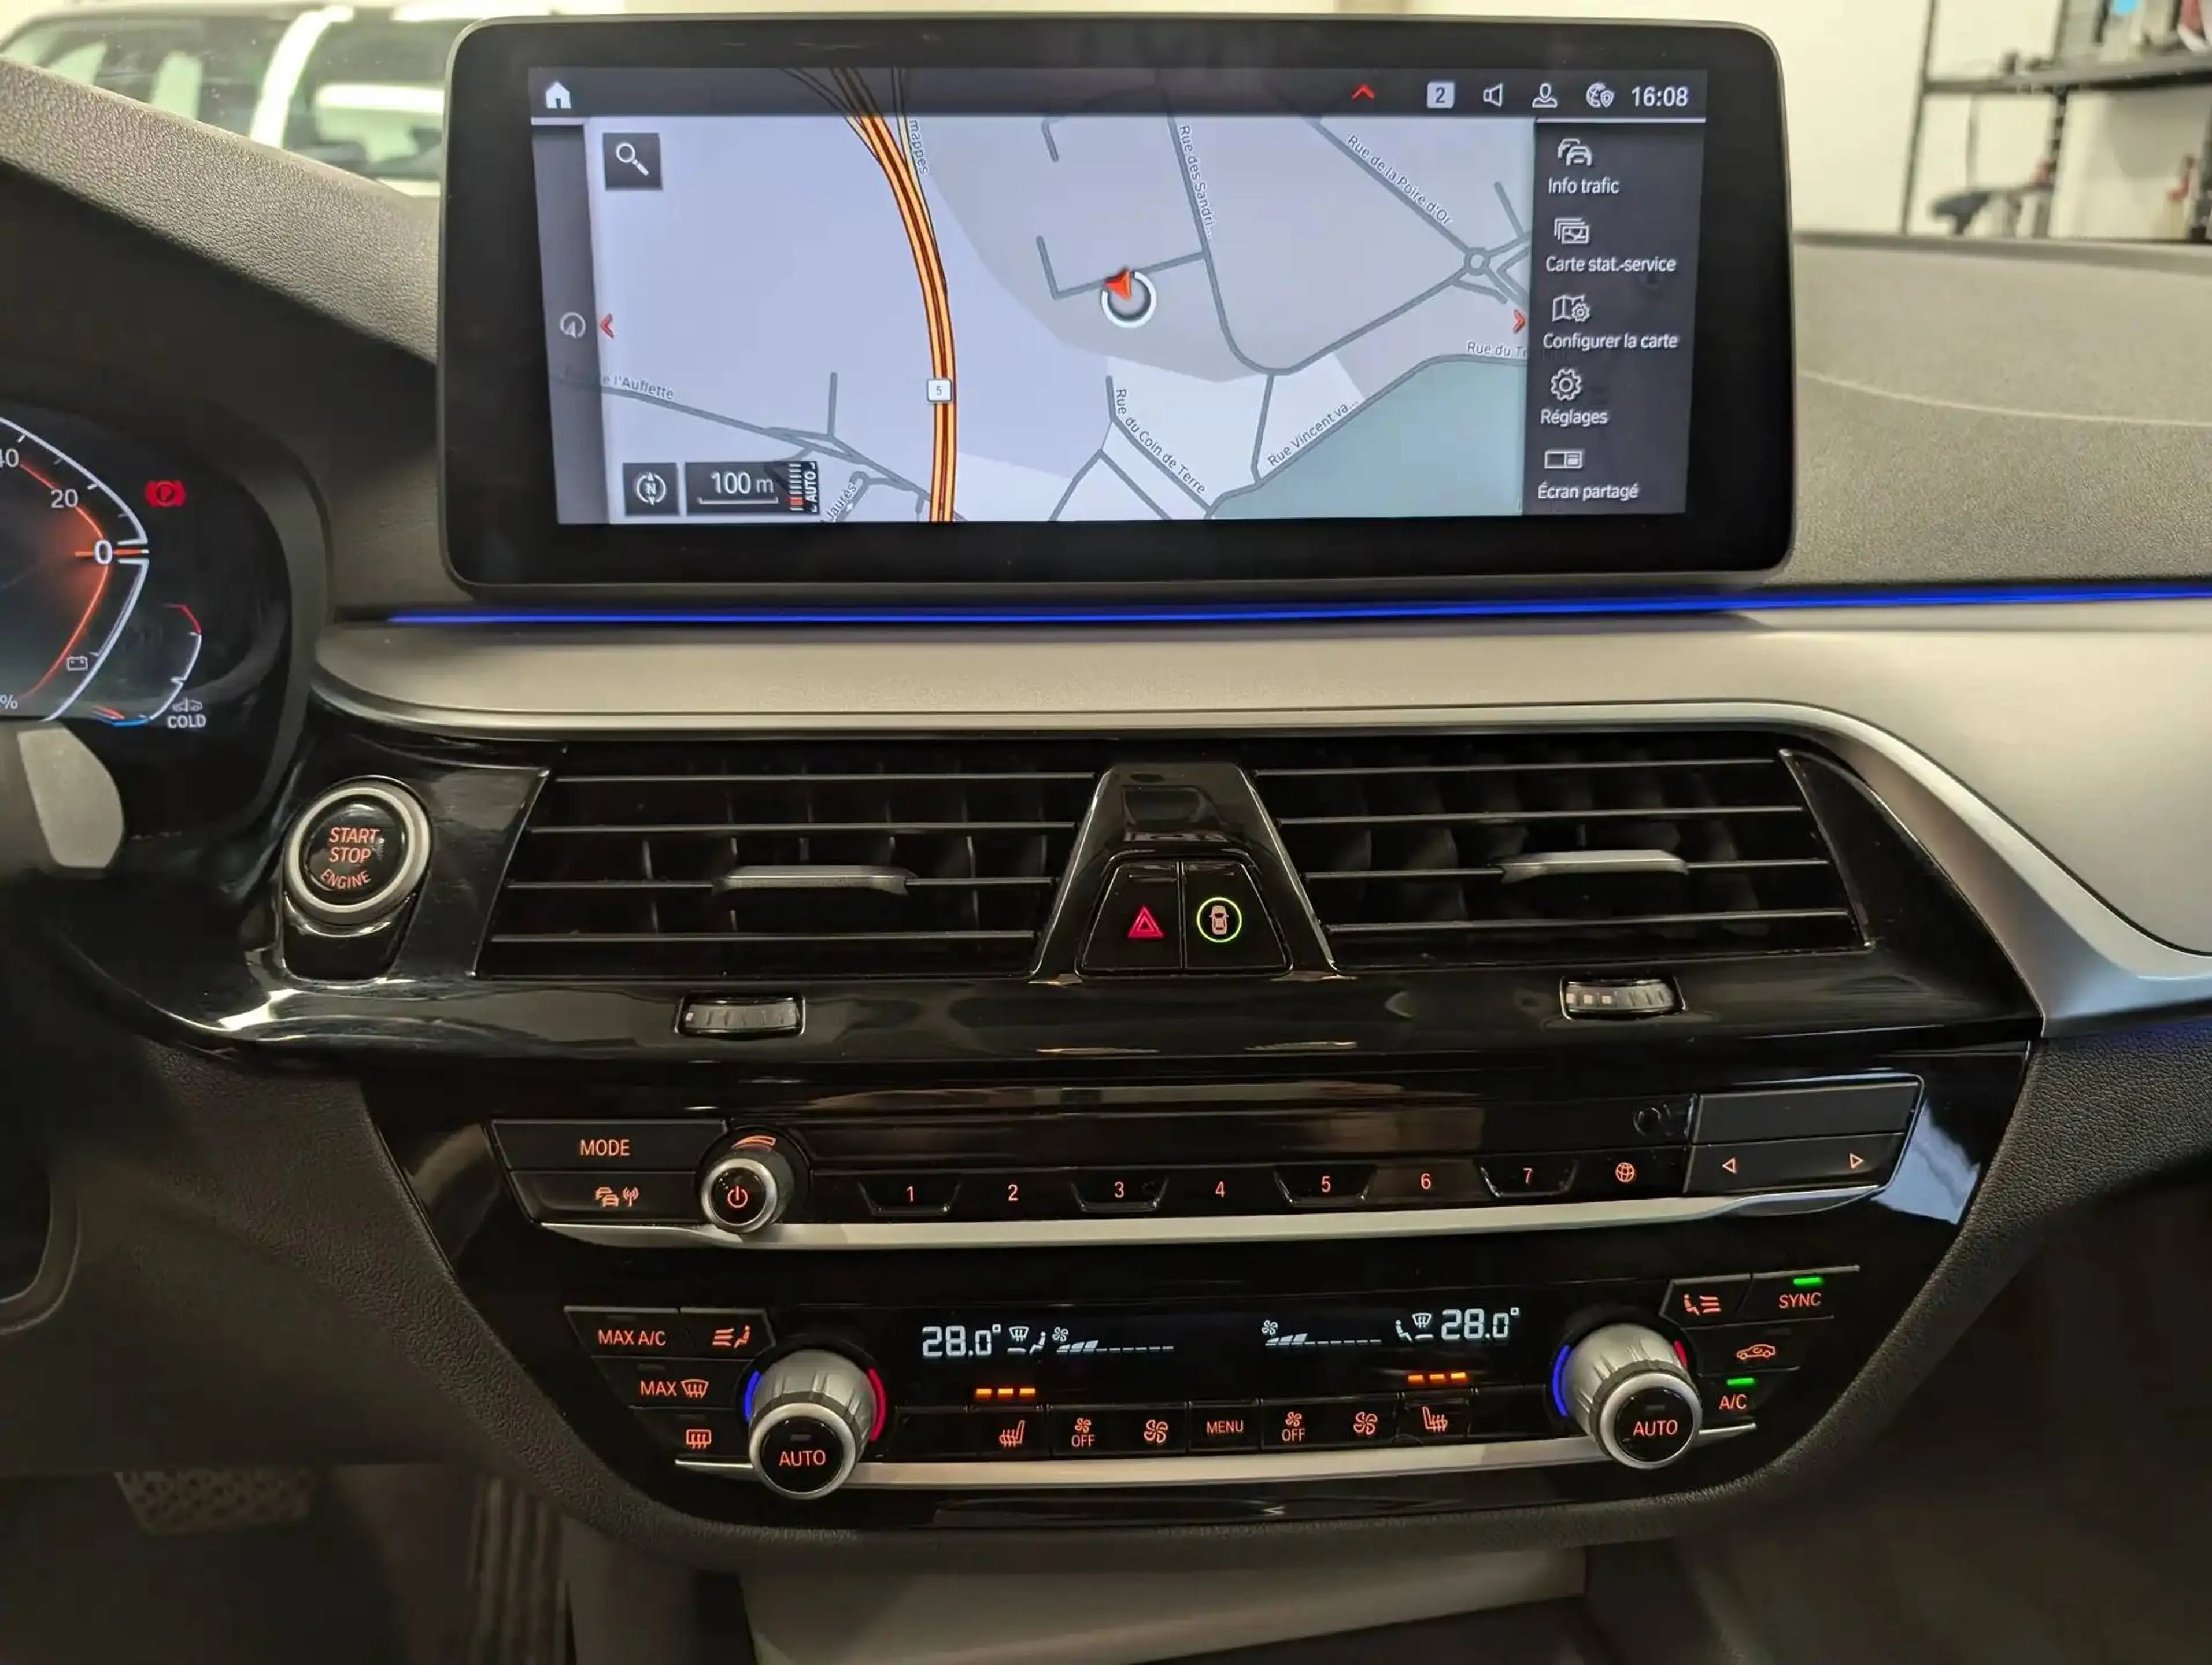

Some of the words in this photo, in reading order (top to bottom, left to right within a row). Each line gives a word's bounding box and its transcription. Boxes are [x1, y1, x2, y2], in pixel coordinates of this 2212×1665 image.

[1435, 87, 1446, 103] 2
[1630, 86, 1688, 108] 16:08
[1180, 125, 1193, 152] Rue
[1187, 156, 1201, 180] des
[1348, 135, 1370, 158] Rue
[1371, 156, 1385, 171] de
[1385, 167, 1396, 182] la
[1397, 176, 1426, 205] Poire
[1426, 202, 1451, 224] d'Or
[1548, 177, 1578, 194] Info
[1580, 177, 1619, 194] trafic
[1545, 256, 1585, 272] Carte
[1588, 256, 1677, 272] stat.-service
[1467, 341, 1492, 355] Rue
[1495, 343, 1511, 357] du
[1543, 332, 1621, 351] Configurer
[1623, 333, 1637, 349] la
[1640, 335, 1678, 349] carte
[1540, 409, 1608, 427] Réglages
[1116, 388, 1127, 415] Rue
[1125, 417, 1140, 433] du
[1139, 431, 1162, 456] Coin
[1162, 453, 1177, 469] de
[1178, 464, 1205, 494] Terre
[1267, 446, 1292, 467] Rue
[1290, 414, 1334, 449] Vincent
[711, 471, 750, 494] 100
[756, 478, 774, 493] m
[804, 471, 817, 502] AUTO
[50, 488, 79, 508] 20
[1538, 482, 1580, 499] Écran
[1582, 482, 1639, 502] partagé
[94, 539, 113, 565] 0
[167, 713, 206, 729] COLD
[329, 827, 380, 844] START
[328, 847, 372, 863] STOP
[321, 868, 372, 889] ENGINE
[580, 1139, 630, 1156] MODE
[1321, 1175, 1331, 1193] 5
[1421, 1172, 1431, 1189] 6
[1523, 1168, 1533, 1184] 7
[907, 1185, 914, 1202] 1
[1008, 1184, 1019, 1201] 2
[1114, 1181, 1125, 1198] 3
[1215, 1181, 1225, 1198] 4
[1778, 1292, 1822, 1309] SYNC
[598, 1329, 635, 1346] MAX
[638, 1330, 667, 1346] A/C
[640, 1380, 677, 1396] MAX
[1718, 1394, 1748, 1411] A/C
[1206, 1420, 1244, 1434] MENU
[1282, 1428, 1305, 1441] OFF
[1632, 1419, 1678, 1437] AUTO
[1071, 1434, 1096, 1447] OFF
[779, 1449, 827, 1467] AUTO
